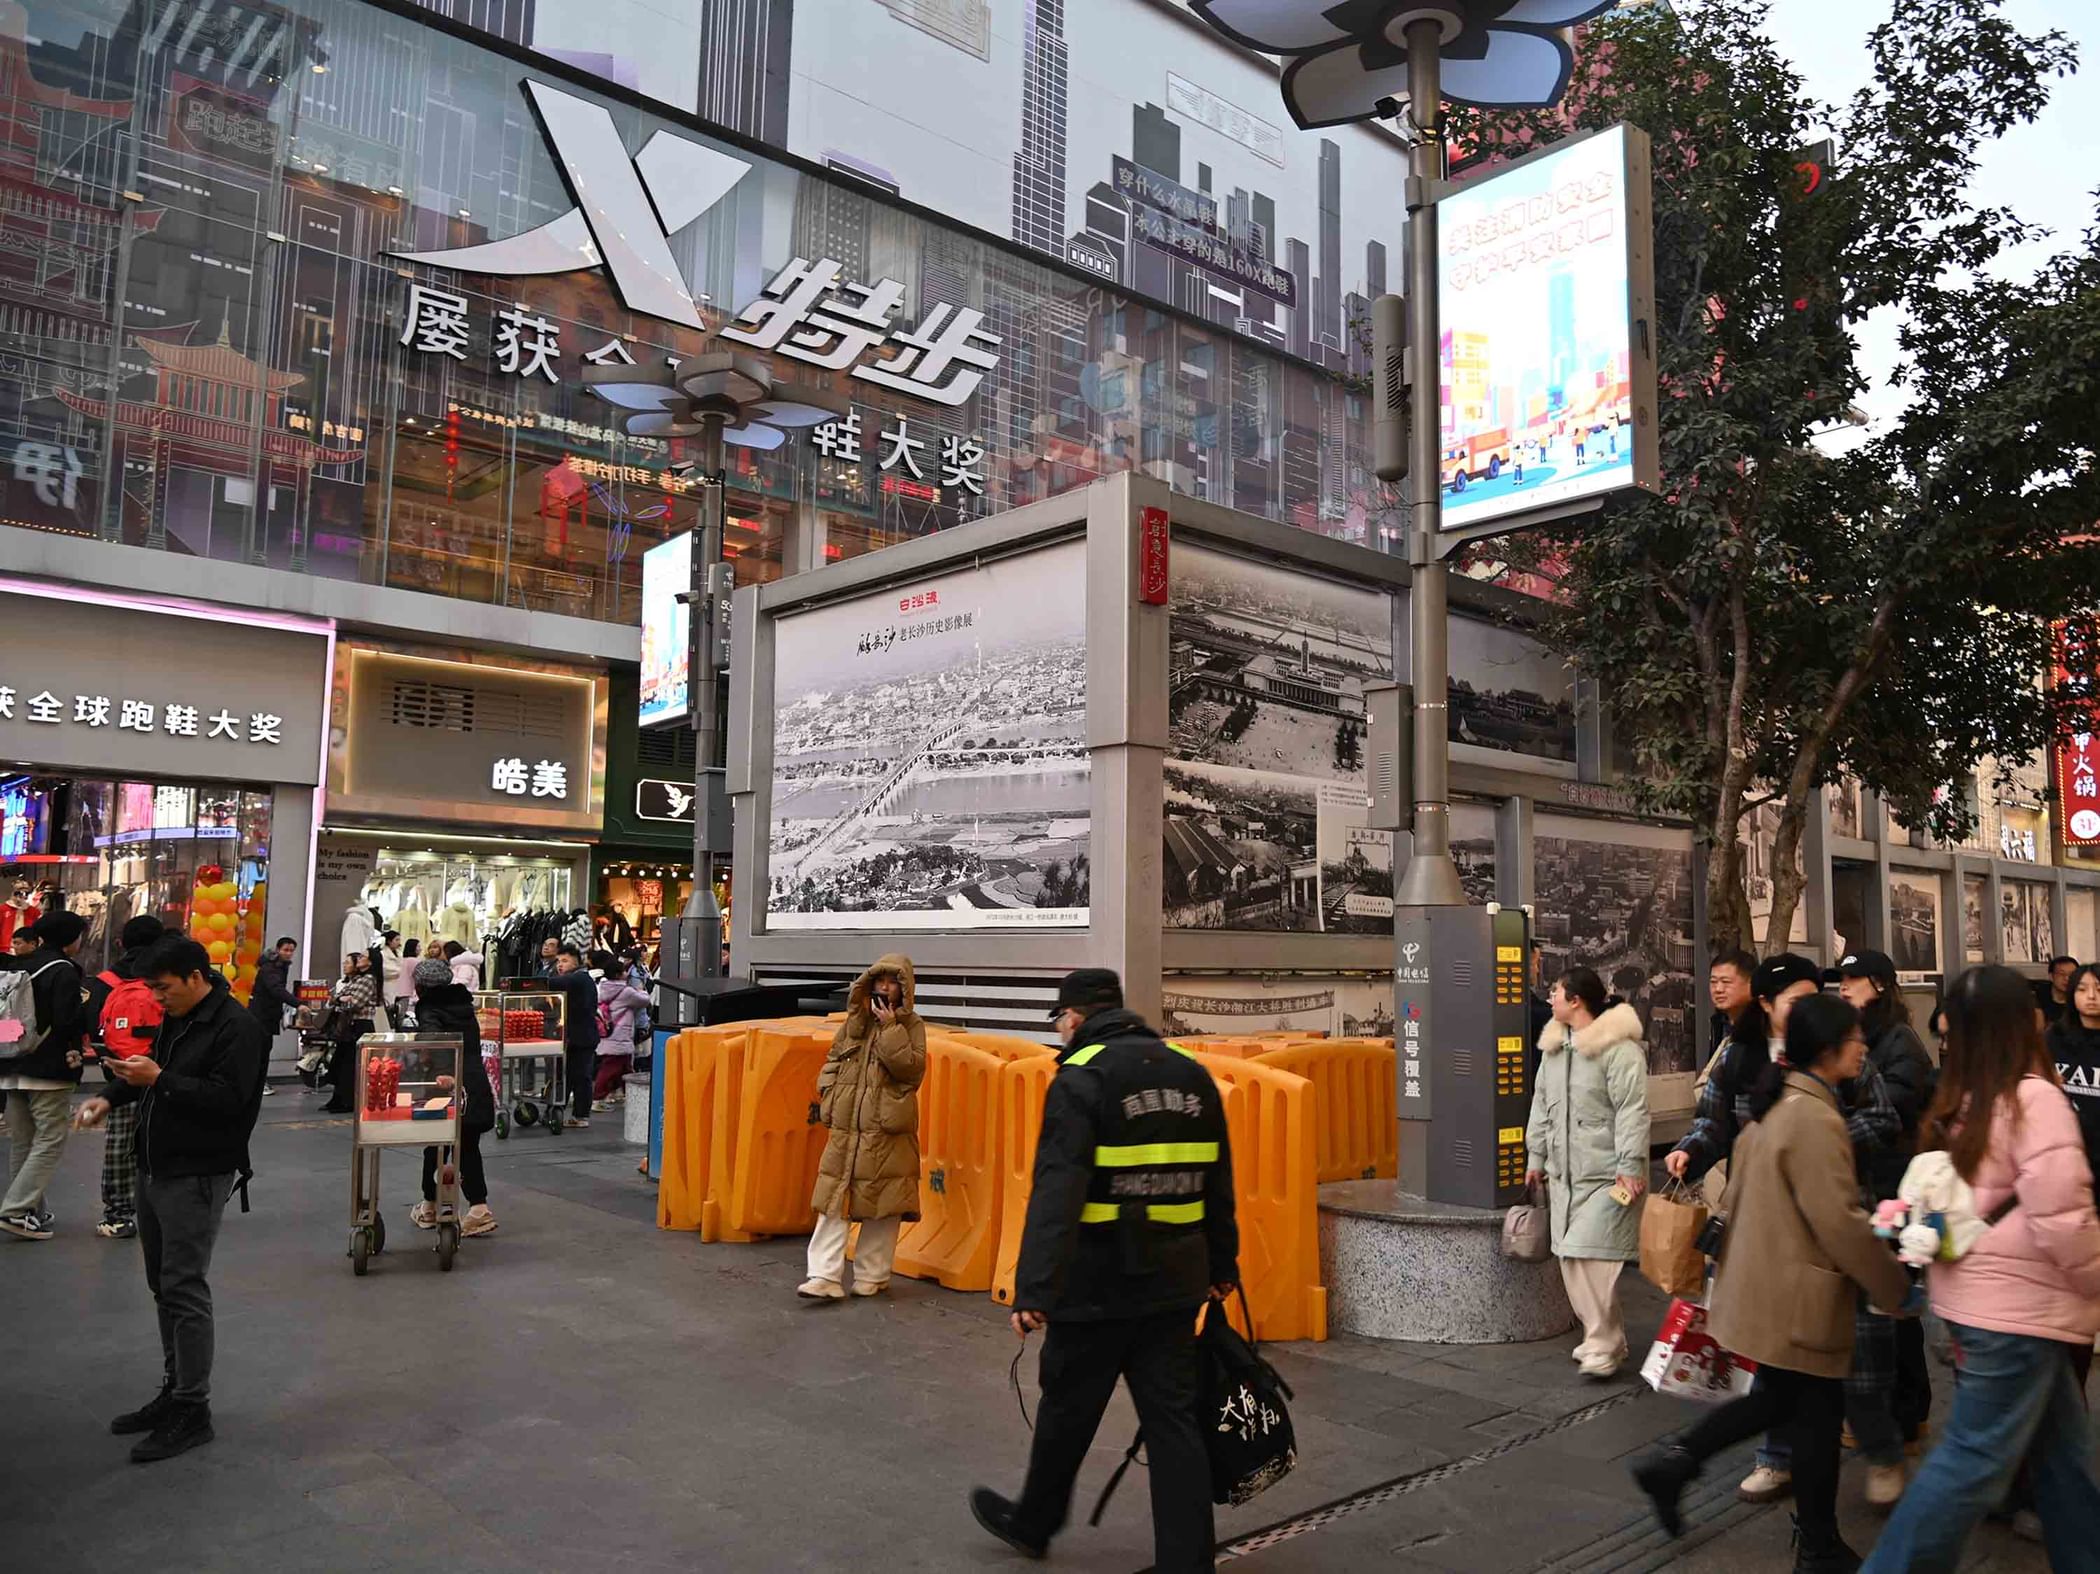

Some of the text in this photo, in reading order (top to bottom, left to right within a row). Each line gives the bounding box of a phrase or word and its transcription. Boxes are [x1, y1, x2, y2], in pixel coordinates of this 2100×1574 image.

[718, 256, 1003, 406] 特步
[900, 612, 973, 642] 老长沙历史影像展
[1404, 1020, 1421, 1098] 信号覆盖
